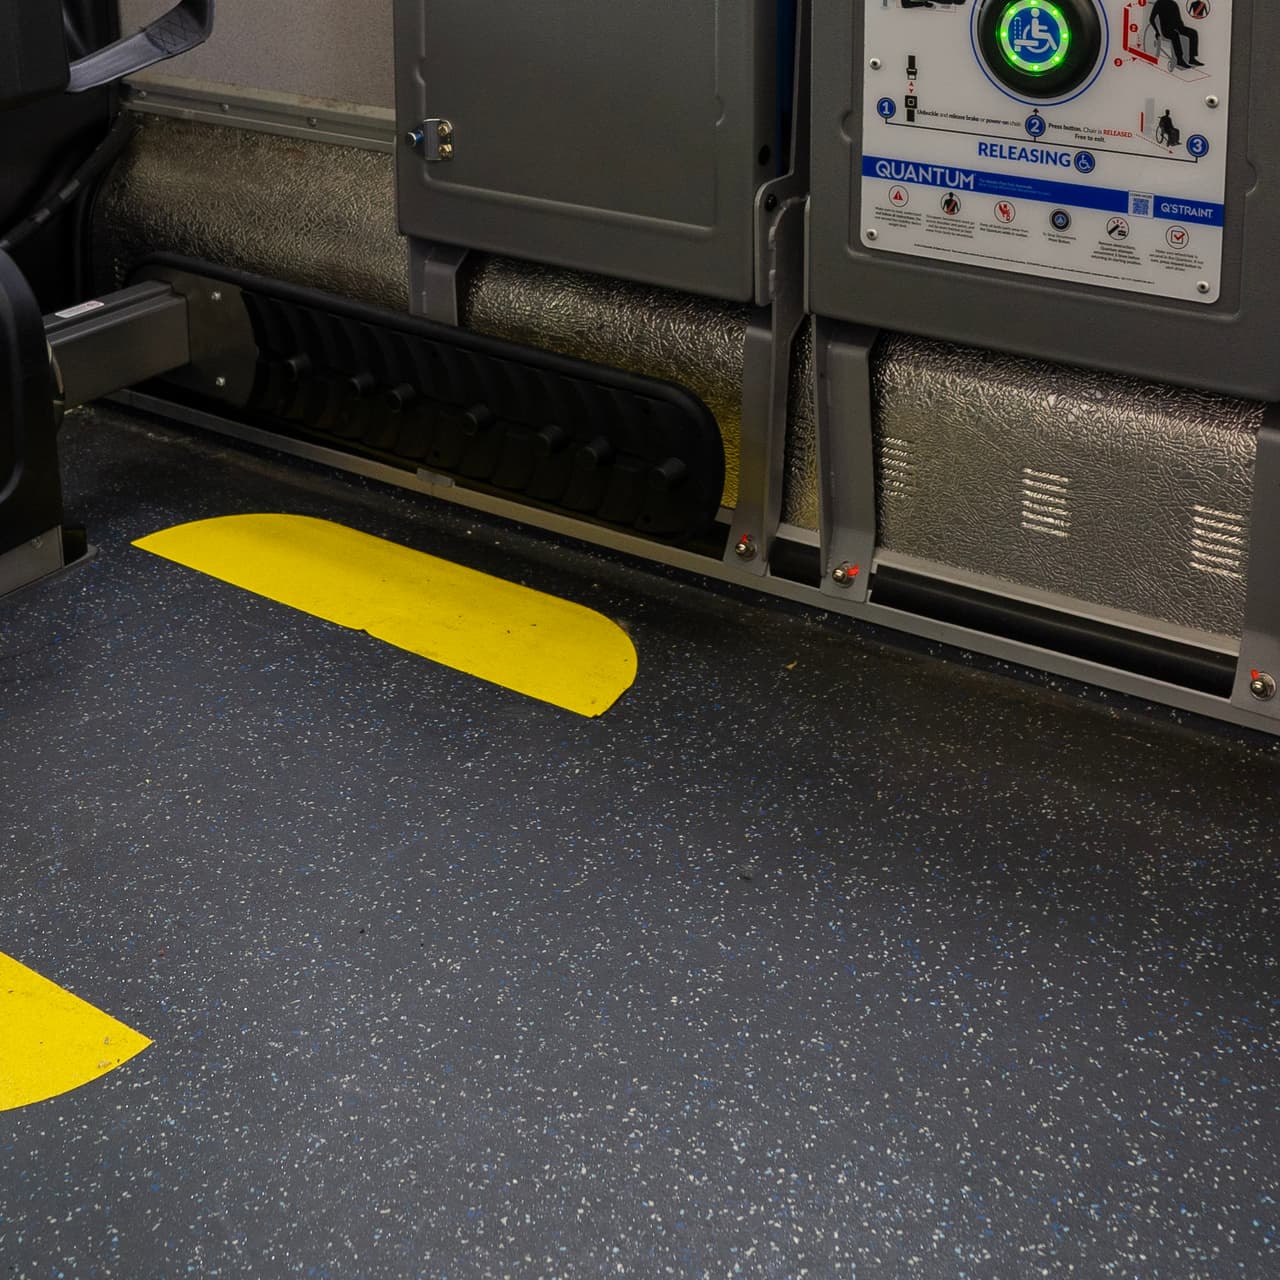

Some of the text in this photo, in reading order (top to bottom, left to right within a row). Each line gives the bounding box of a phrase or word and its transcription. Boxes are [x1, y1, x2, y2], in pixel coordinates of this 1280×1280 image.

[966, 114, 979, 122] brake
[1048, 122, 1062, 130] Press
[1083, 126, 1098, 134] Chair
[1103, 129, 1132, 138] RELEASED
[1074, 133, 1087, 141] Free
[978, 141, 1071, 168] RELEASING
[875, 160, 975, 190] QUANTUM
[1160, 202, 1214, 218] Q'STRAINT
